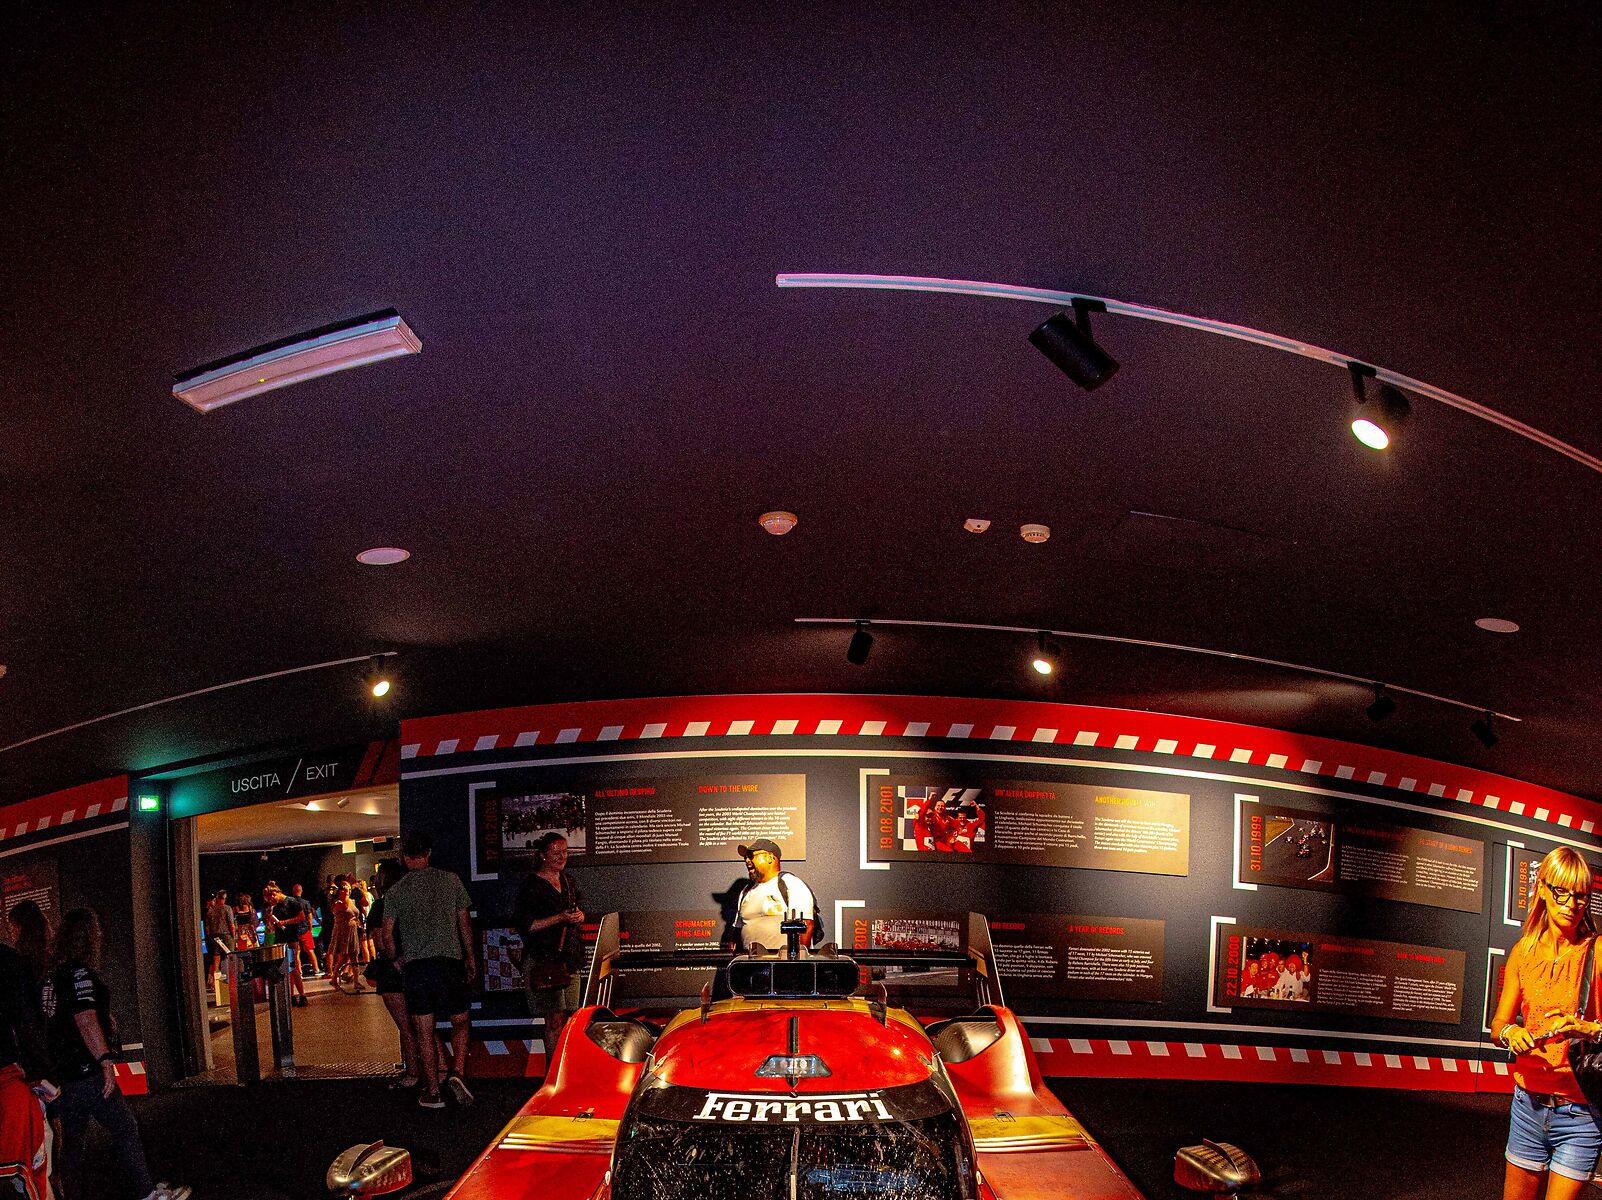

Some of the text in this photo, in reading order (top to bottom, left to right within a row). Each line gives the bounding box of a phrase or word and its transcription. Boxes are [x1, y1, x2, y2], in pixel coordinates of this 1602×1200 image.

[231, 772, 281, 793] USCITA
[305, 763, 338, 780] EXIT
[880, 785, 893, 849] 19.08.2001
[1249, 815, 1263, 872] 31.10.1999
[1517, 860, 1528, 910] 15.10.1983
[1225, 935, 1241, 998] 22.10.2000
[693, 1092, 893, 1122] Ferrari
